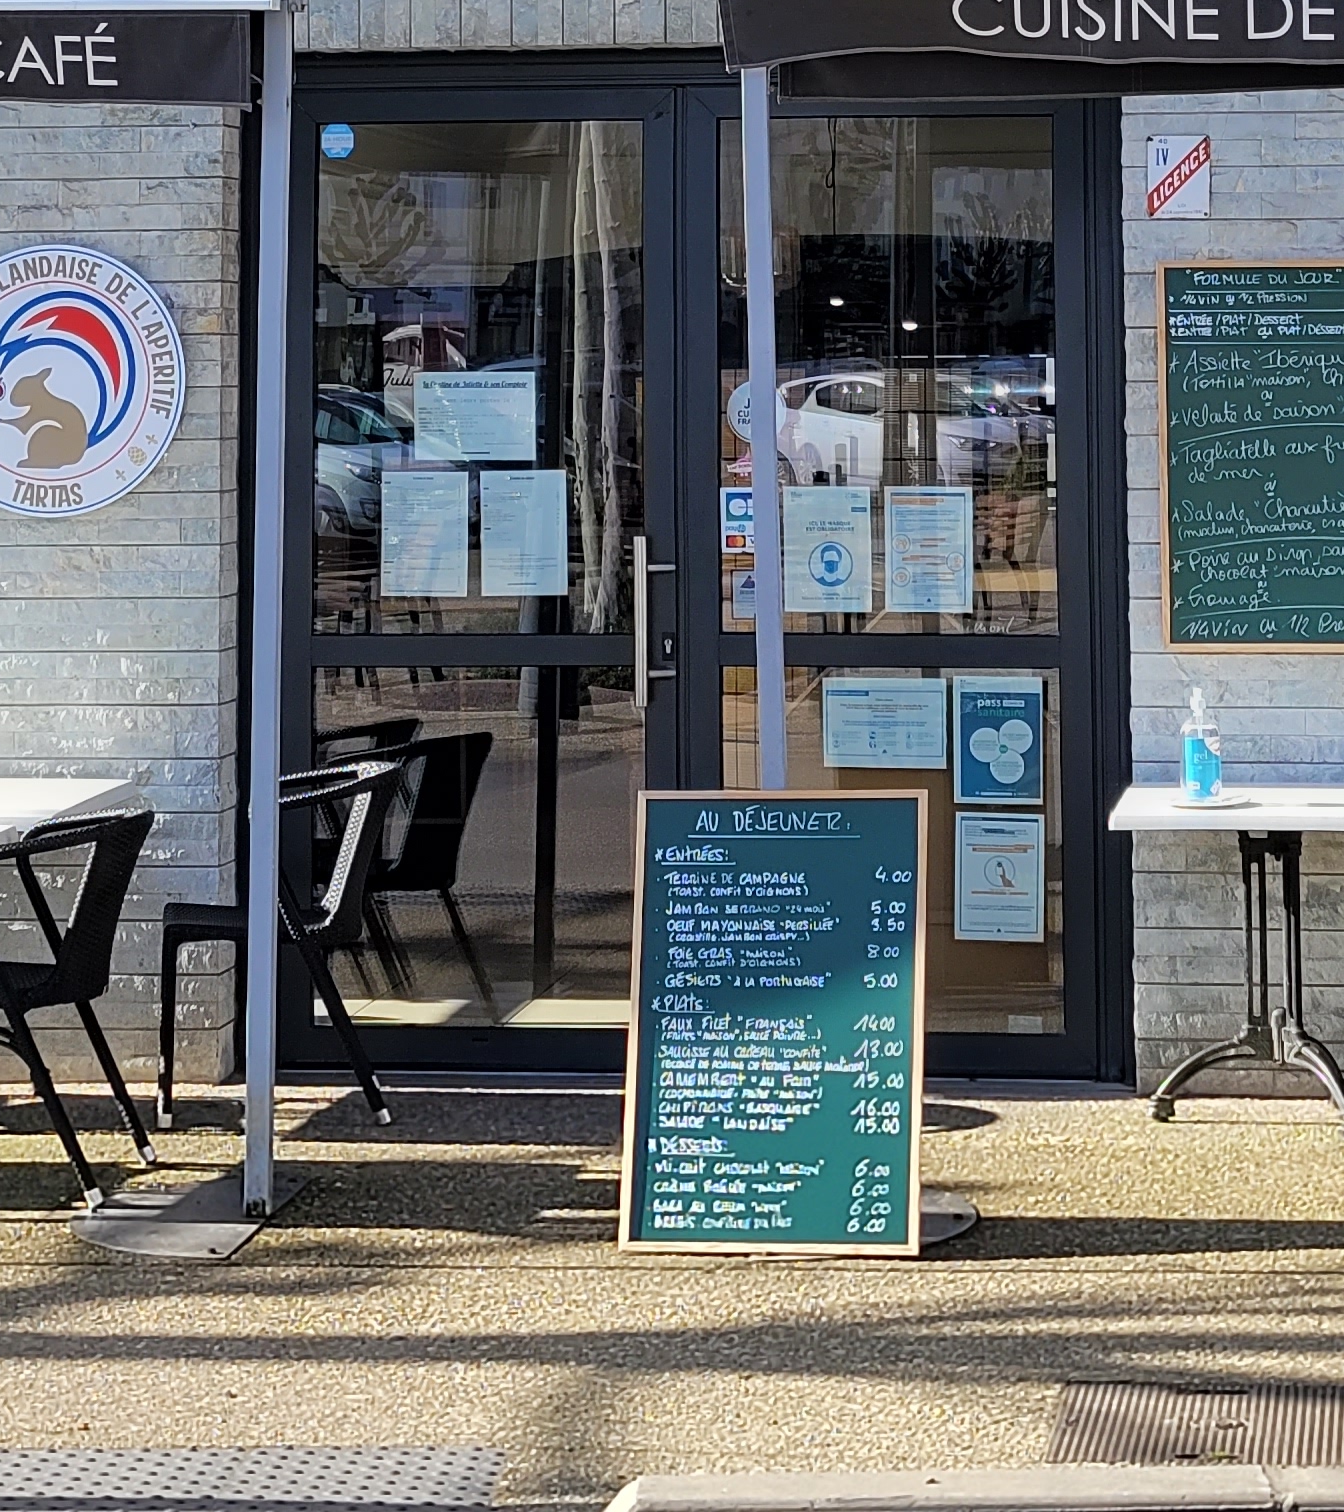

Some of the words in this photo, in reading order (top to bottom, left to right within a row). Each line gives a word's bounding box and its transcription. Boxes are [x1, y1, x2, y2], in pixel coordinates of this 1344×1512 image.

[1156, 148, 1169, 166] IV
[1152, 141, 1207, 209] LICENCE
[1268, 272, 1288, 285] DU
[1257, 292, 1307, 303] PRESSION
[104, 272, 137, 305] DE
[130, 299, 176, 420] L'APERITIF
[1184, 350, 1251, 373] Assiette
[1182, 404, 1238, 427] Velouté
[1244, 404, 1262, 422] de
[1272, 399, 1336, 420] saison
[1179, 440, 1276, 472] Tagliatelle
[1284, 442, 1320, 456] aux
[1188, 466, 1207, 484] de
[12, 479, 84, 508] TARTAS
[1189, 550, 1230, 572] Poire
[1236, 550, 1258, 566] au
[1200, 564, 1268, 583] chocolat
[1288, 614, 1310, 637] 1/2
[977, 698, 1002, 708] pass
[1193, 750, 1208, 764] gel
[696, 810, 719, 832] AU
[664, 872, 717, 885] TERRINE
[722, 872, 734, 884] DE
[739, 871, 806, 886] CAMPAGNE
[875, 866, 912, 883] 4.00
[710, 886, 741, 897] CONFIT
[665, 900, 718, 916] JAMBON
[725, 904, 781, 914] SERRANO
[870, 900, 906, 915] 5.00
[666, 919, 696, 932] OEUF
[700, 918, 776, 932] MAYONNAISE
[668, 946, 694, 960] FOIE
[697, 946, 733, 960] GRAS
[867, 944, 900, 958] 8.00
[664, 972, 722, 988] GÉSIERS
[744, 976, 756, 988] LA
[863, 972, 898, 988] 5.00
[660, 1016, 692, 1030] FAUX
[702, 1014, 732, 1030] FILET
[658, 1044, 711, 1058] SAUCISSE
[712, 1045, 730, 1058] AU
[854, 1039, 904, 1058] 13.00
[660, 1072, 746, 1087] CAMEMBERT
[853, 1072, 904, 1089] 15.00
[850, 1097, 900, 1116] 16.00
[854, 1117, 900, 1134] 15.00
[855, 1160, 890, 1176] 6.00
[852, 1181, 890, 1198] 6.00
[849, 1198, 892, 1215] 6.00
[847, 1217, 886, 1233] 6.00
